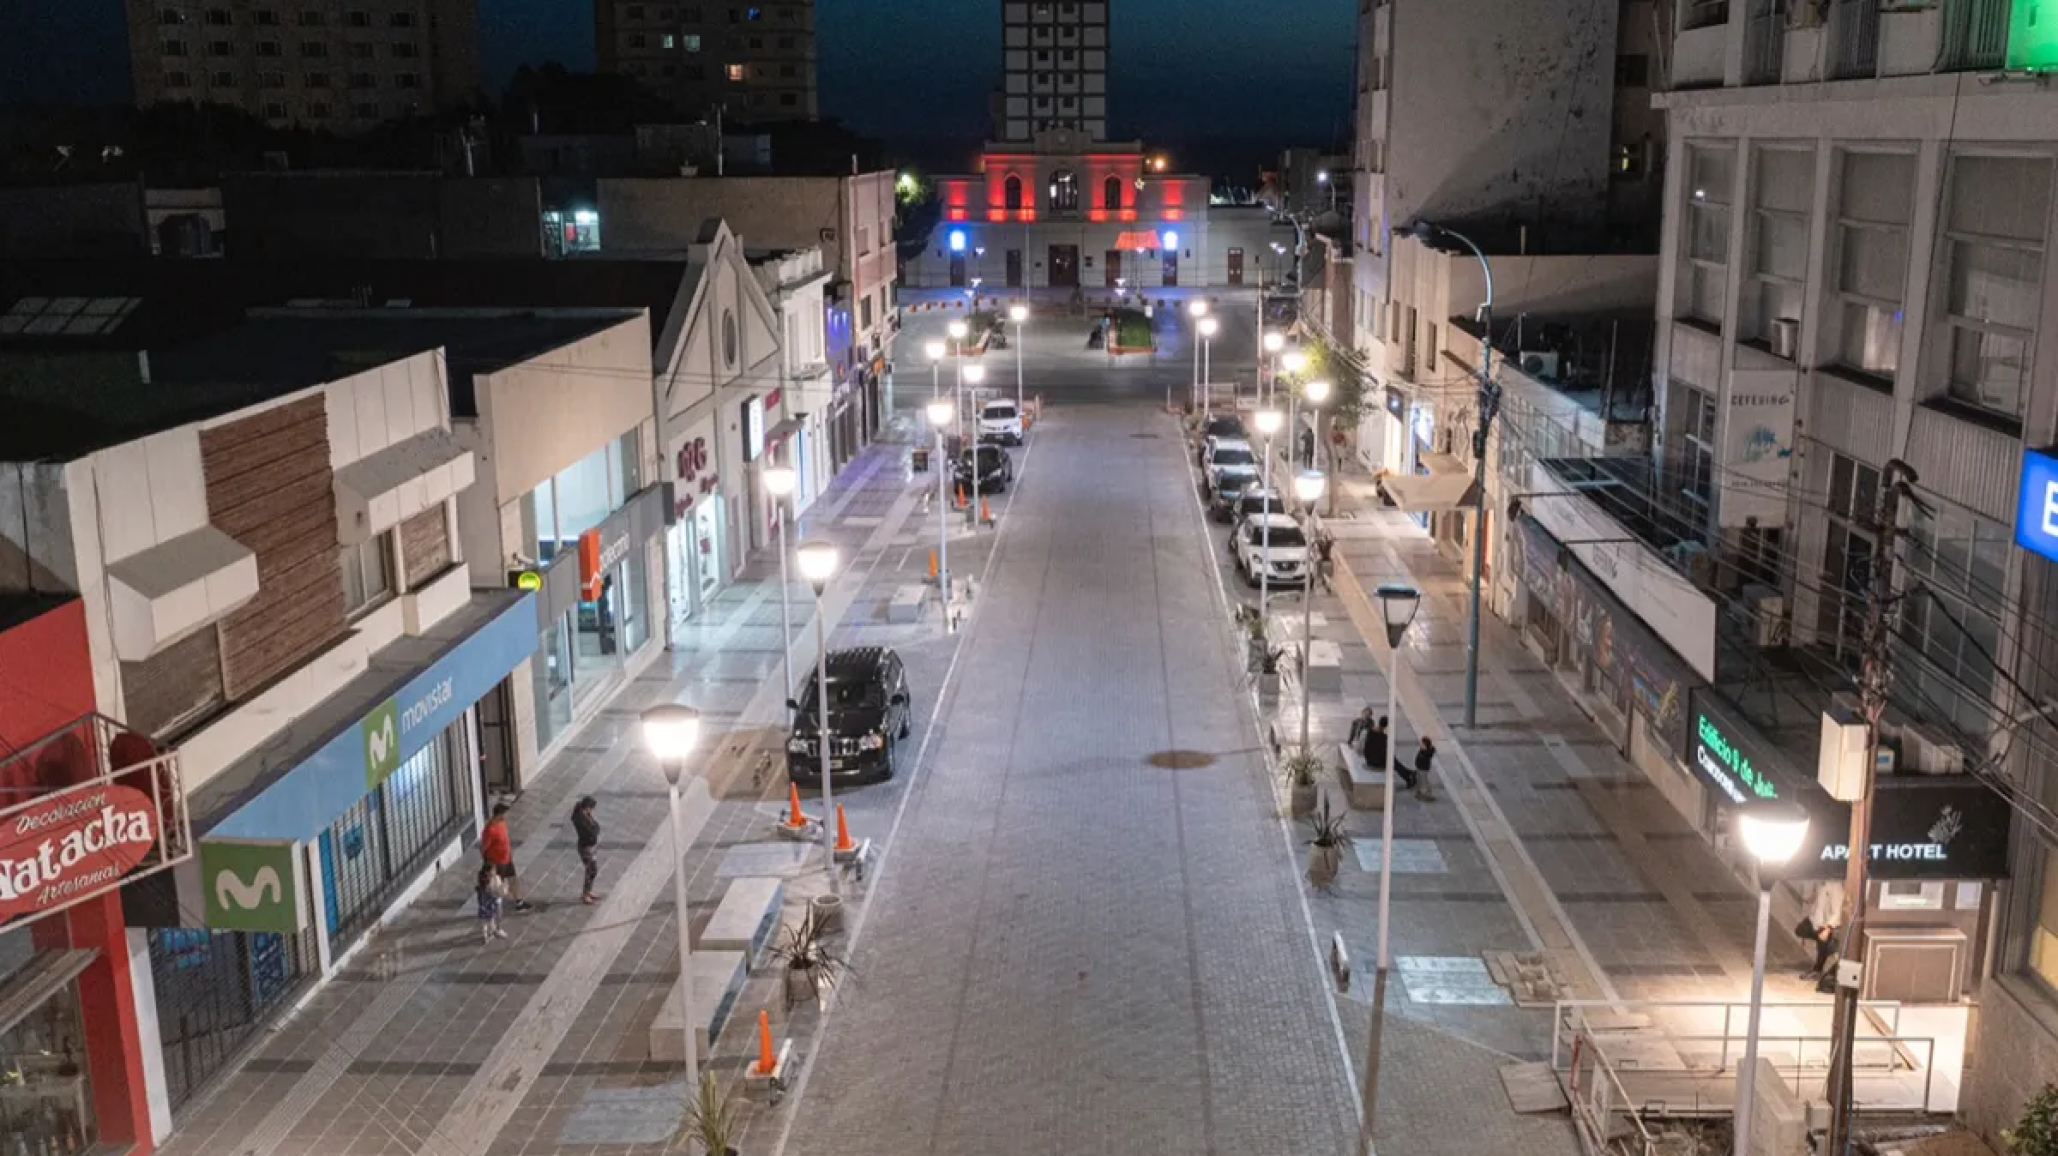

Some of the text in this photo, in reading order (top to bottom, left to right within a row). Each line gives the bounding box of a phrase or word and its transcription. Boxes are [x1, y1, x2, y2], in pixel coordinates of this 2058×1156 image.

[402, 676, 454, 735] movistar
[1741, 758, 1753, 788] de
[1820, 843, 1948, 860] APT HOTEL
